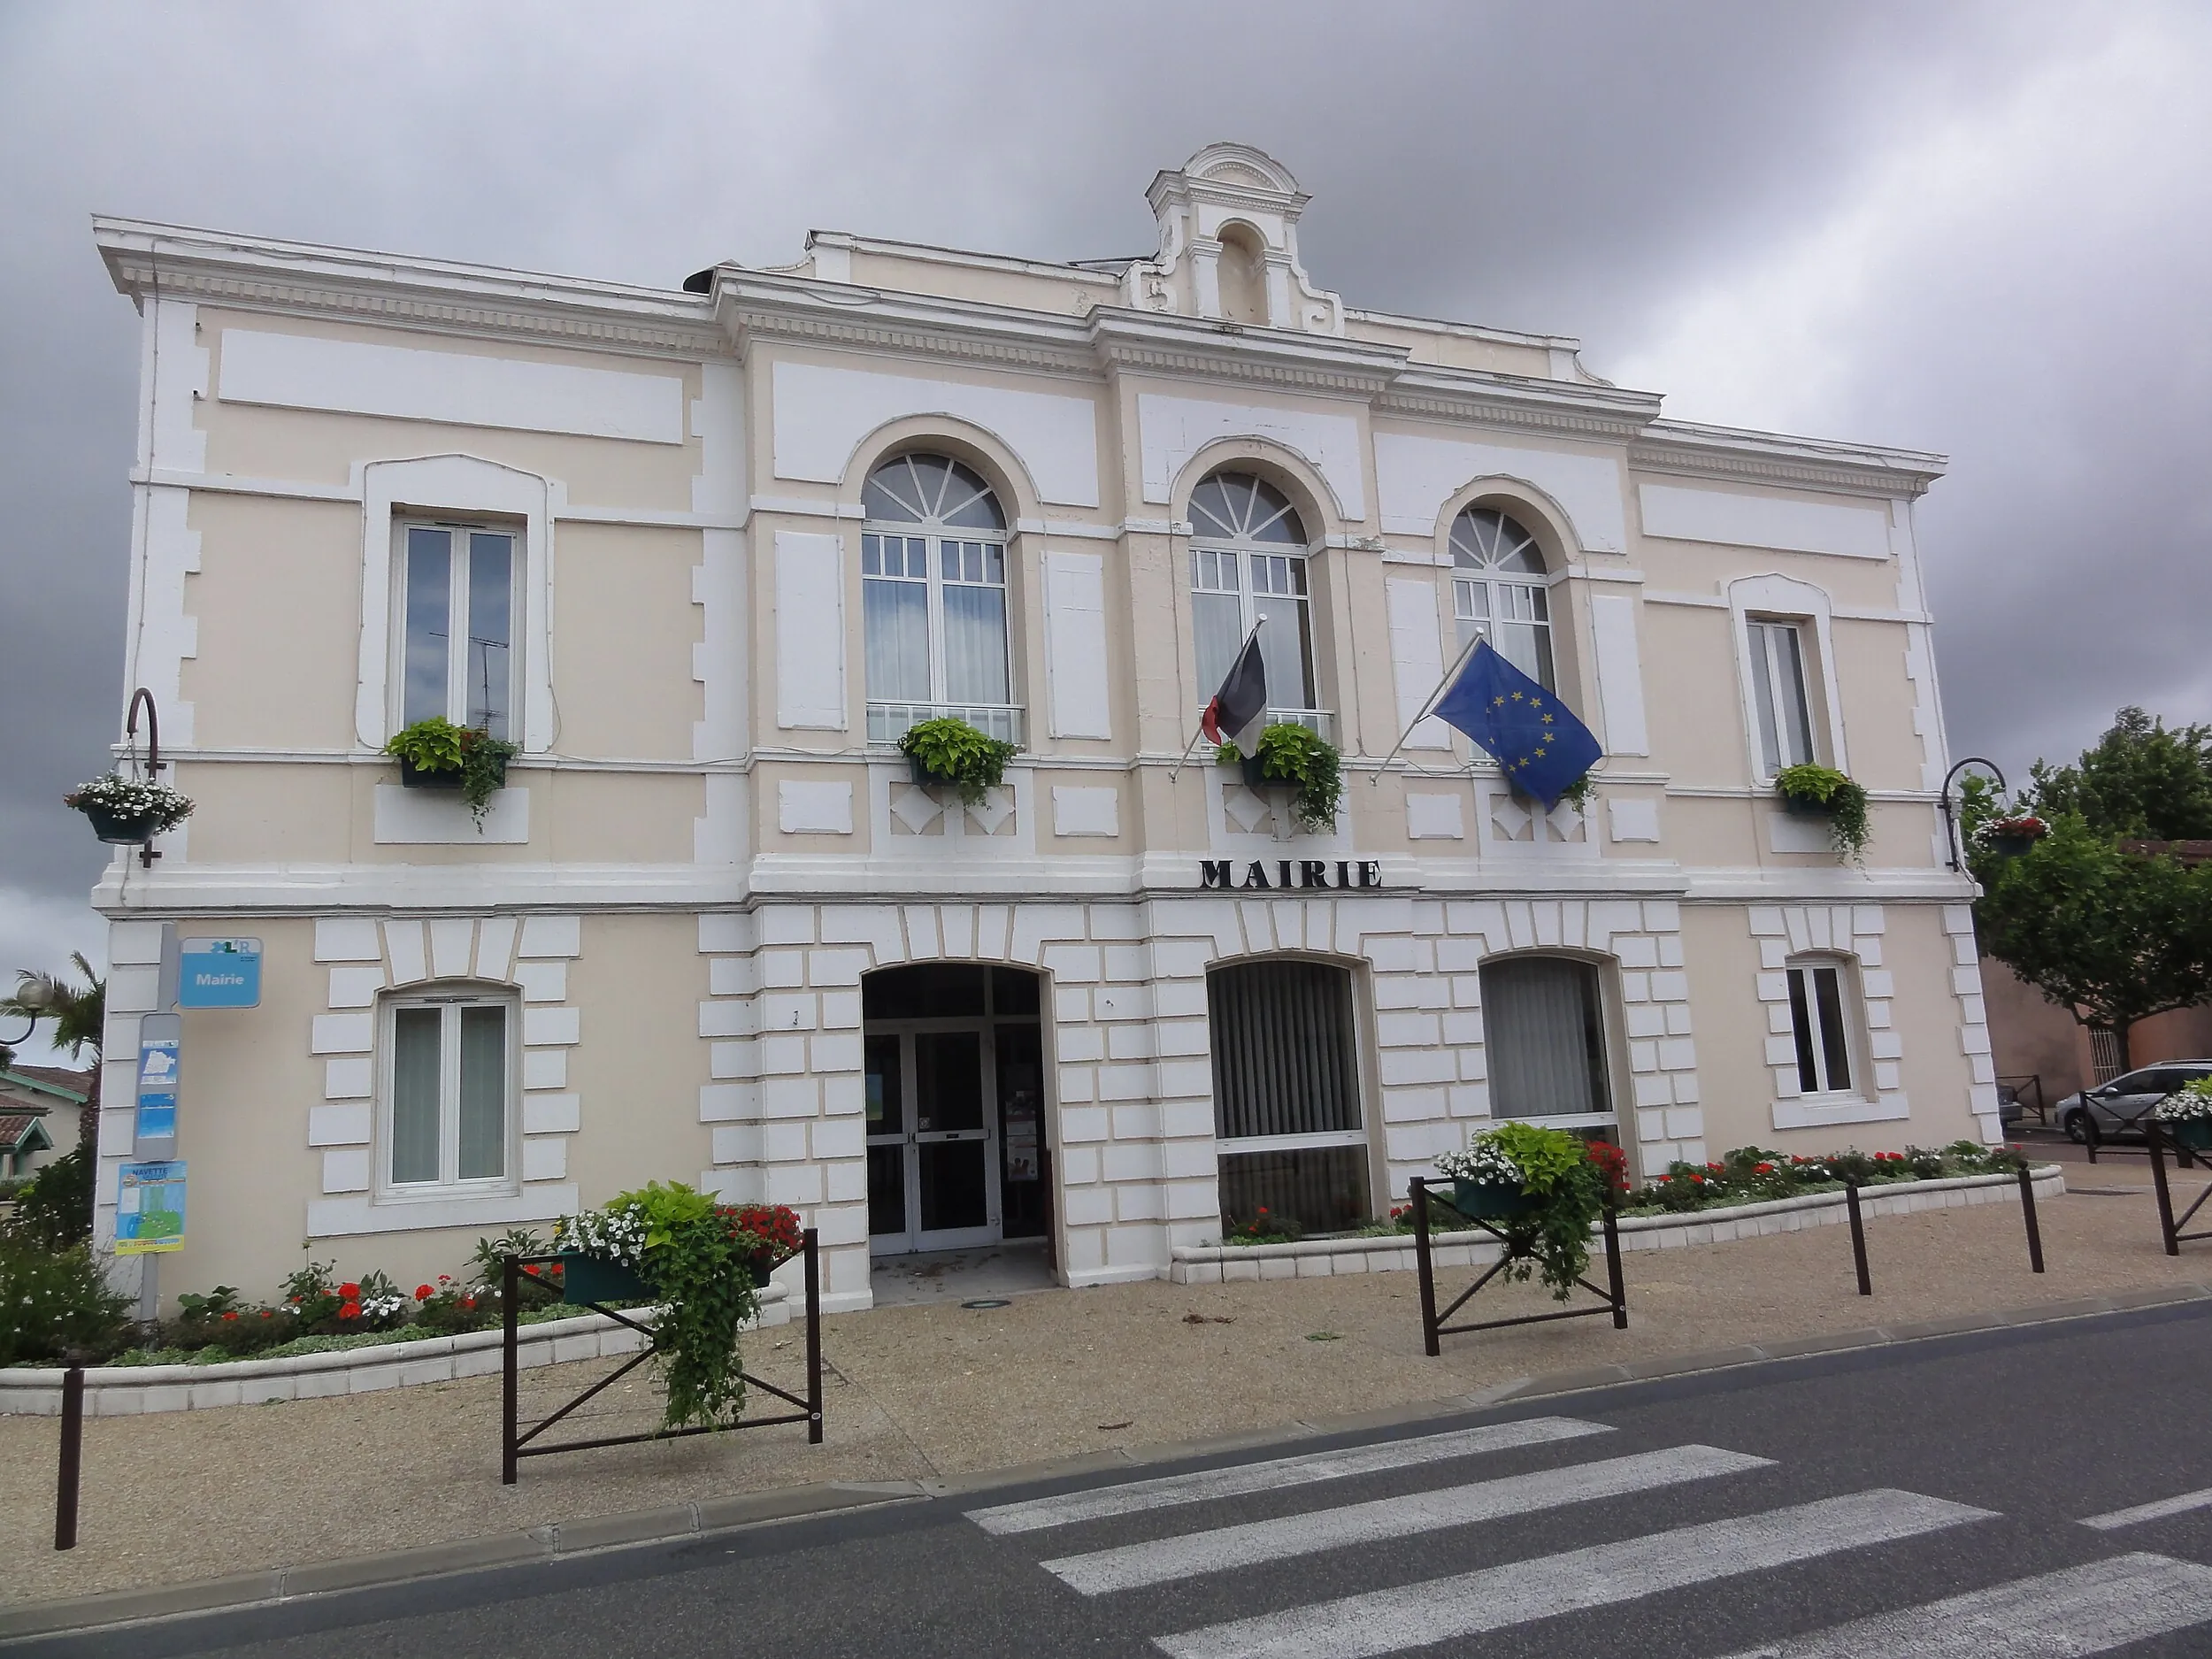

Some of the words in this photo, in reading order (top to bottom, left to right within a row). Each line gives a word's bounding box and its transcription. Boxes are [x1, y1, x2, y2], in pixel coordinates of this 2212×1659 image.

[1198, 859, 1382, 889] MAIRIE
[196, 973, 244, 986] Mairie
[132, 1167, 168, 1176] NAVETTE
